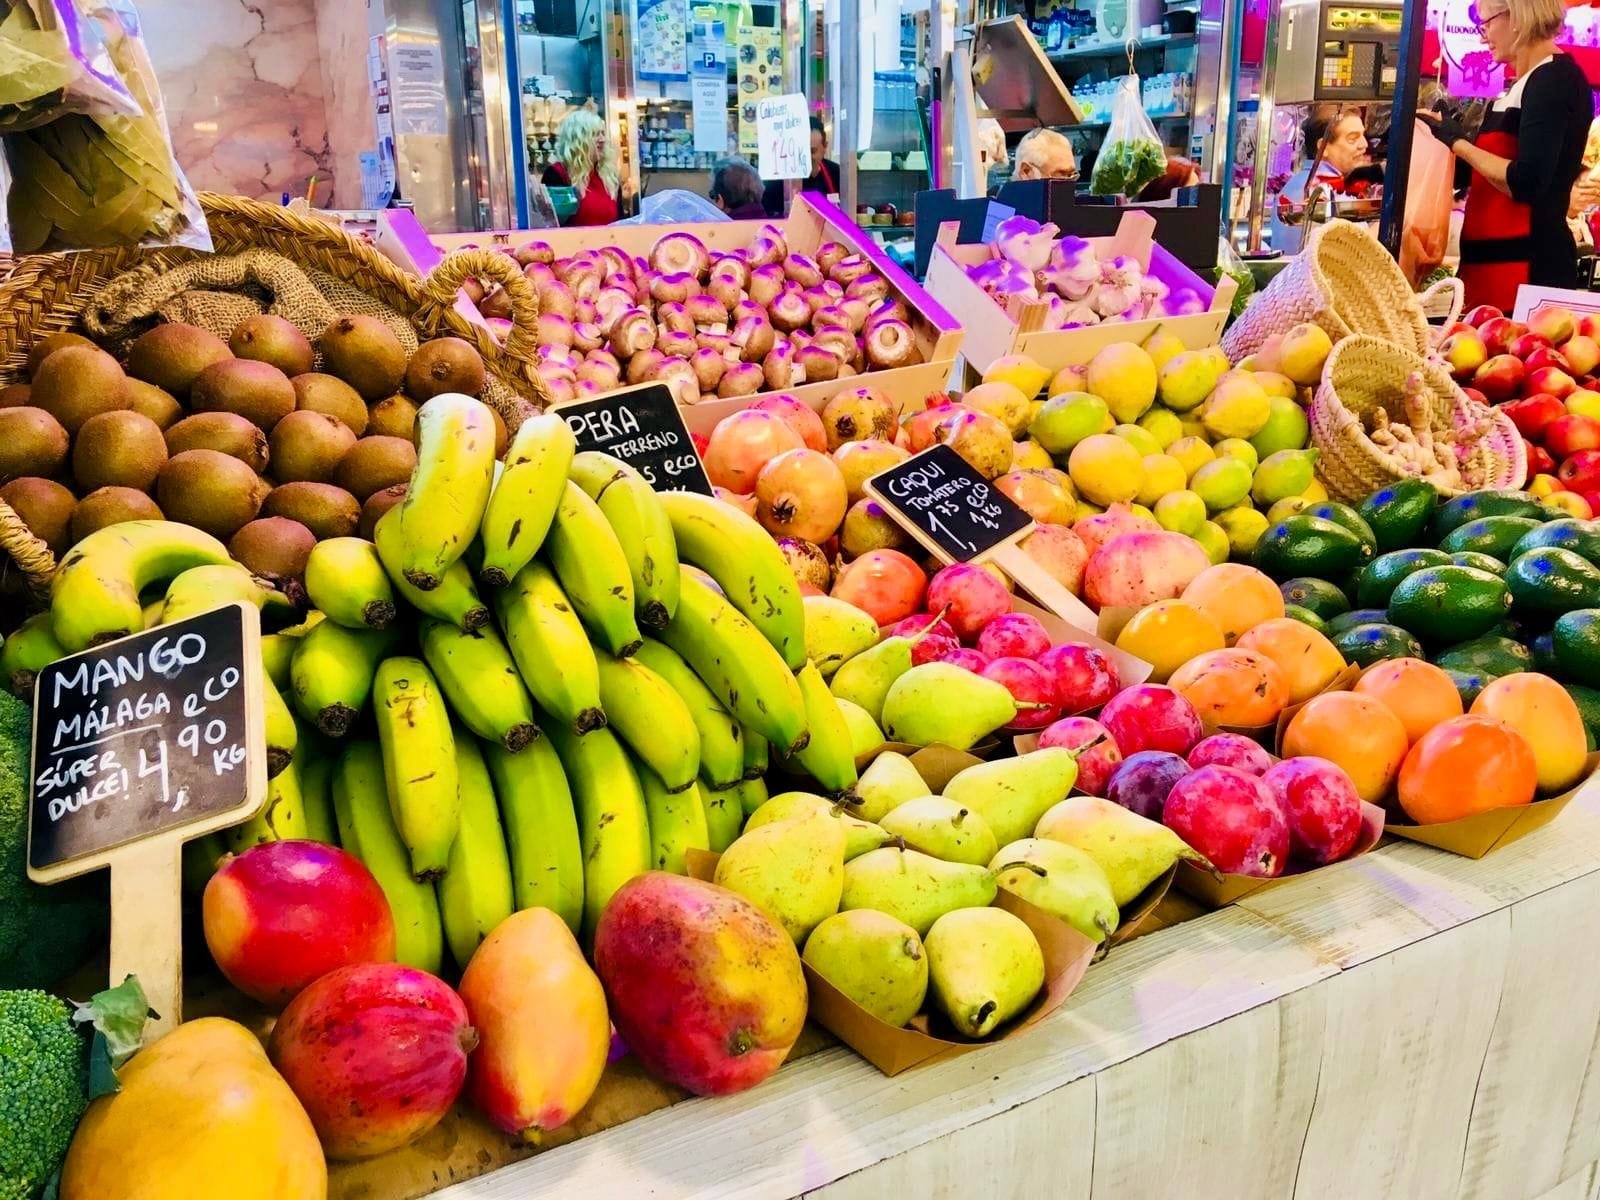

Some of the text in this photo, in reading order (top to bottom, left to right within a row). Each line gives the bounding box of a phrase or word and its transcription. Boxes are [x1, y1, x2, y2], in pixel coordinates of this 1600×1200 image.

[565, 406, 640, 446] PERA
[608, 431, 679, 459] TERRENO
[888, 461, 946, 497] CAQUI
[905, 477, 972, 510] TOMATERO
[53, 633, 206, 708] MANGO
[52, 692, 171, 748] MÁLAGA
[35, 750, 122, 798] SÚPER
[213, 744, 246, 776] KG
[48, 768, 130, 822] DULCE!
